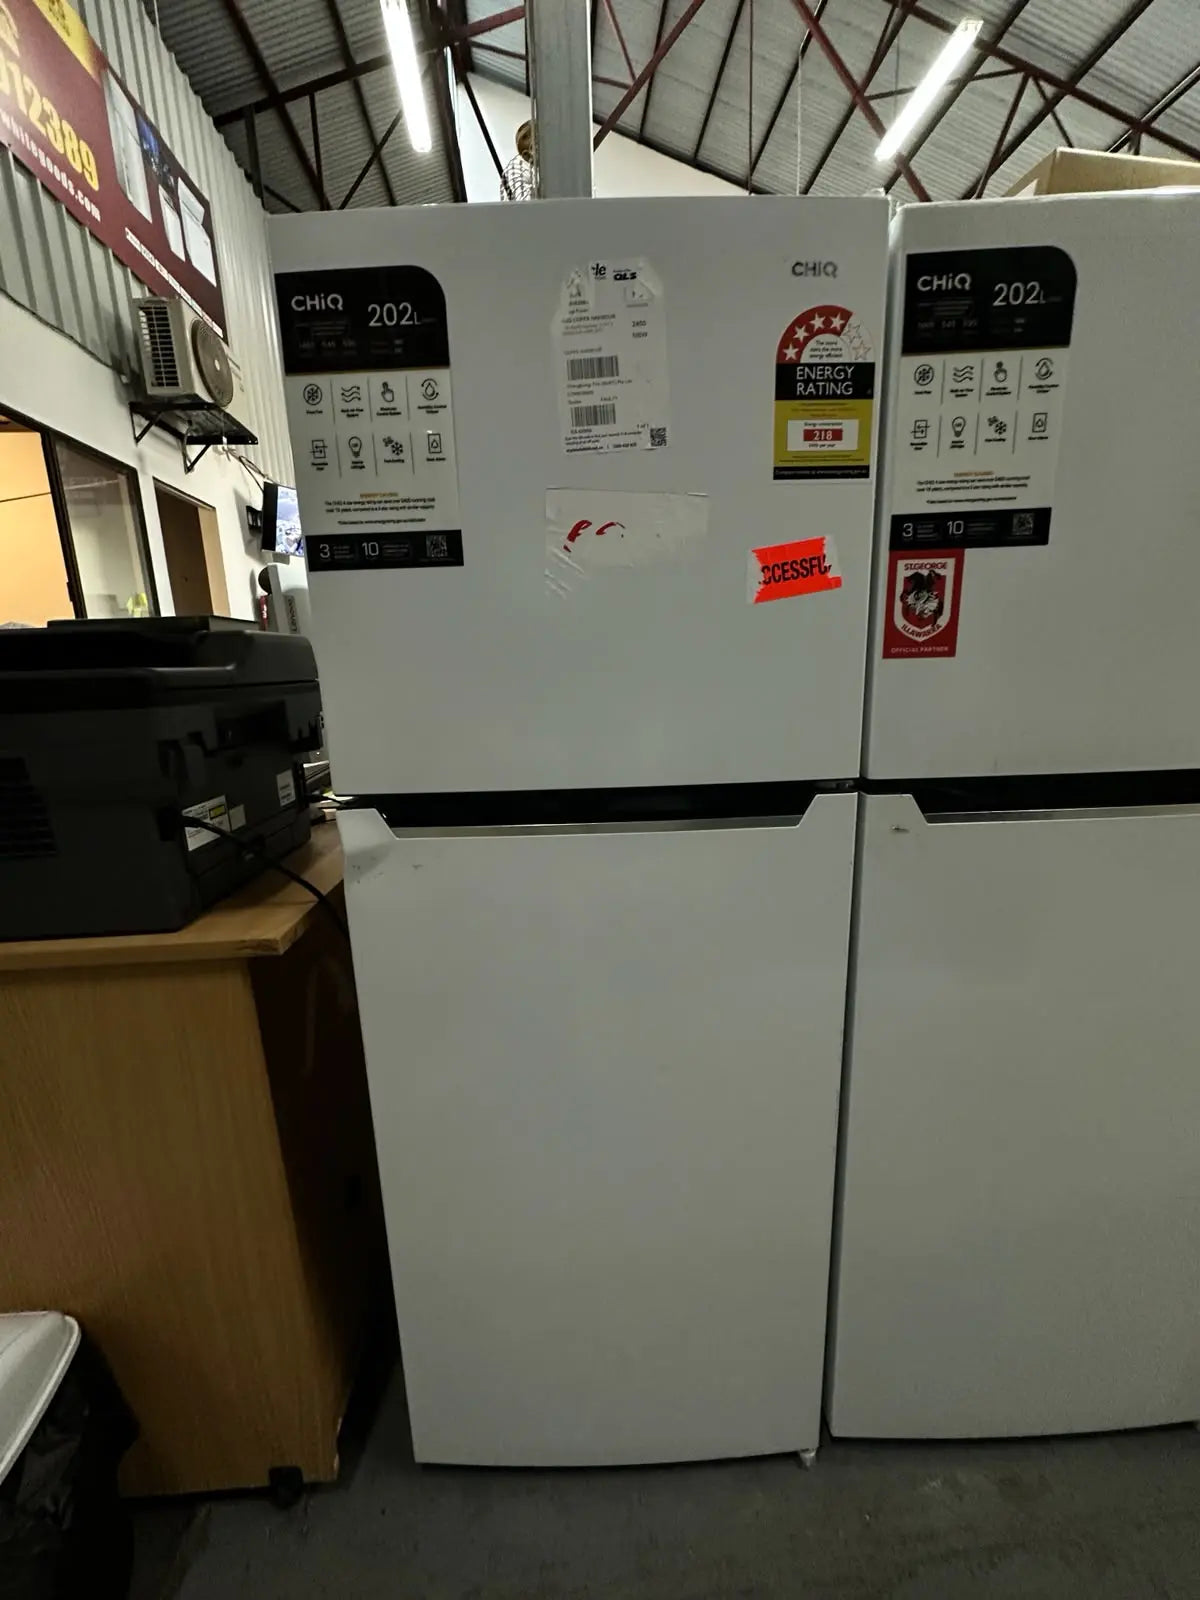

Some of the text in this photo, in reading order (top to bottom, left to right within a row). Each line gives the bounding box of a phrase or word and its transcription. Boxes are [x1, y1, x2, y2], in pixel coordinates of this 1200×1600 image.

[796, 365, 855, 380] ENERGY
[796, 381, 853, 396] RATING
[813, 430, 833, 440] 218
[902, 520, 965, 537] 3 10
[319, 541, 380, 559] 3 10
